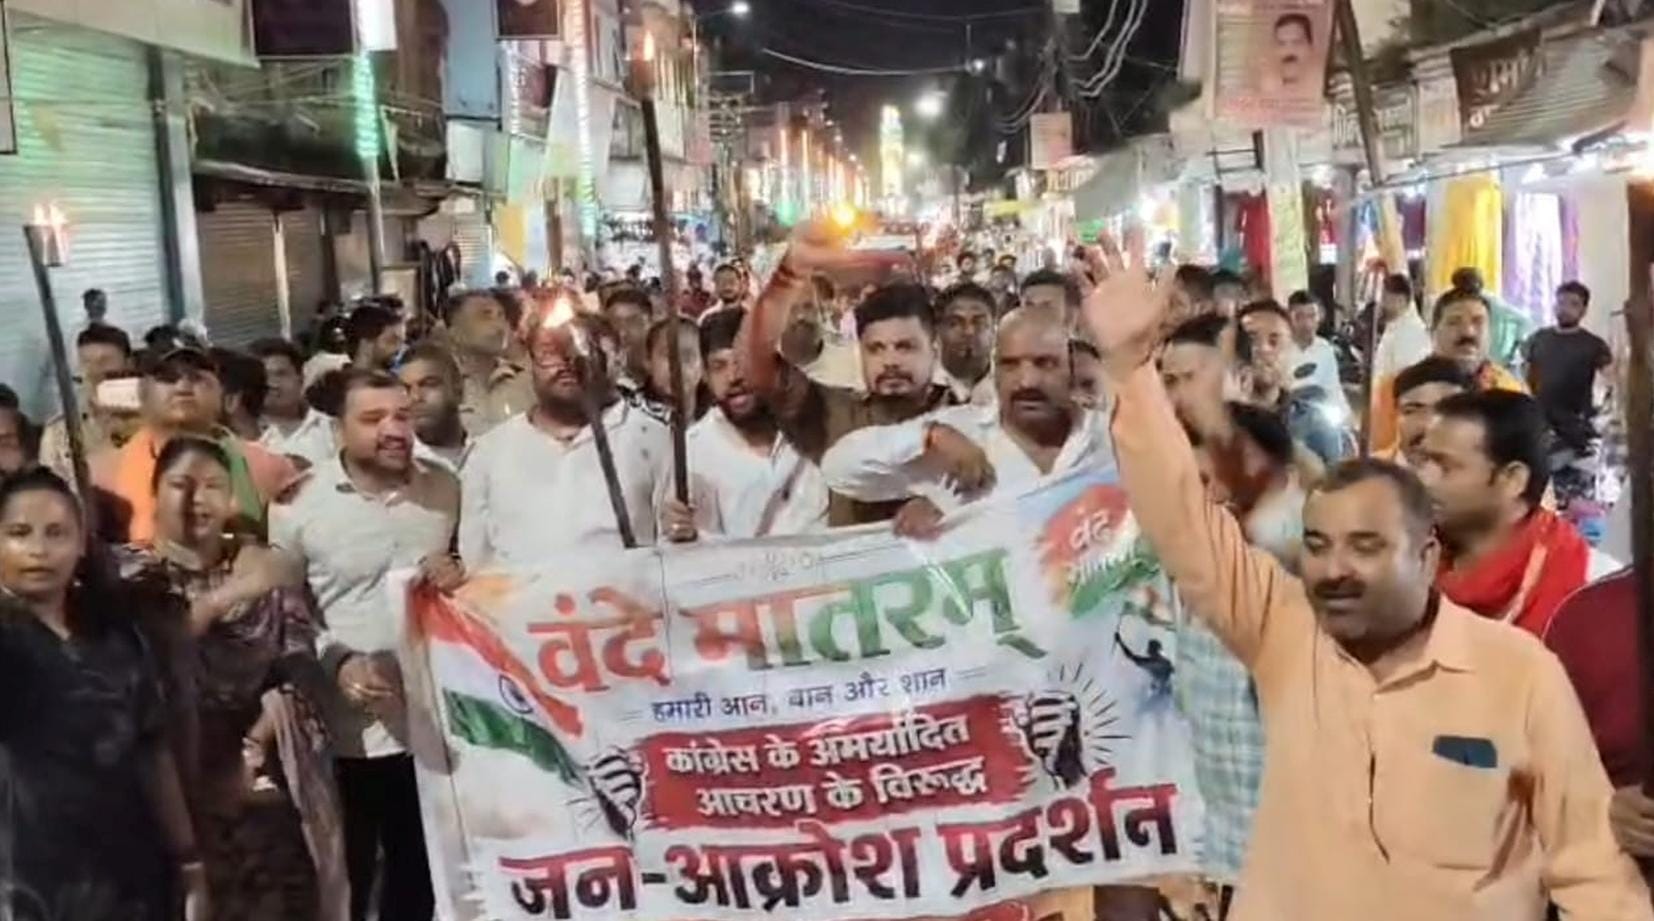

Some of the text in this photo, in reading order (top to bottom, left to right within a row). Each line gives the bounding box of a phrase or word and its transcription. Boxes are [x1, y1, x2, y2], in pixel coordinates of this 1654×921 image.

[527, 549, 1047, 692] वंदे मातरम्
[652, 692, 711, 721] हमारी
[843, 671, 890, 702] और
[900, 668, 946, 695] शान
[661, 738, 760, 775] कांग्रेस
[764, 733, 800, 769] के
[696, 784, 817, 816] आचरण
[820, 771, 864, 809] के
[498, 767, 1178, 920] जन-आक्रोश प्रदर्शन
